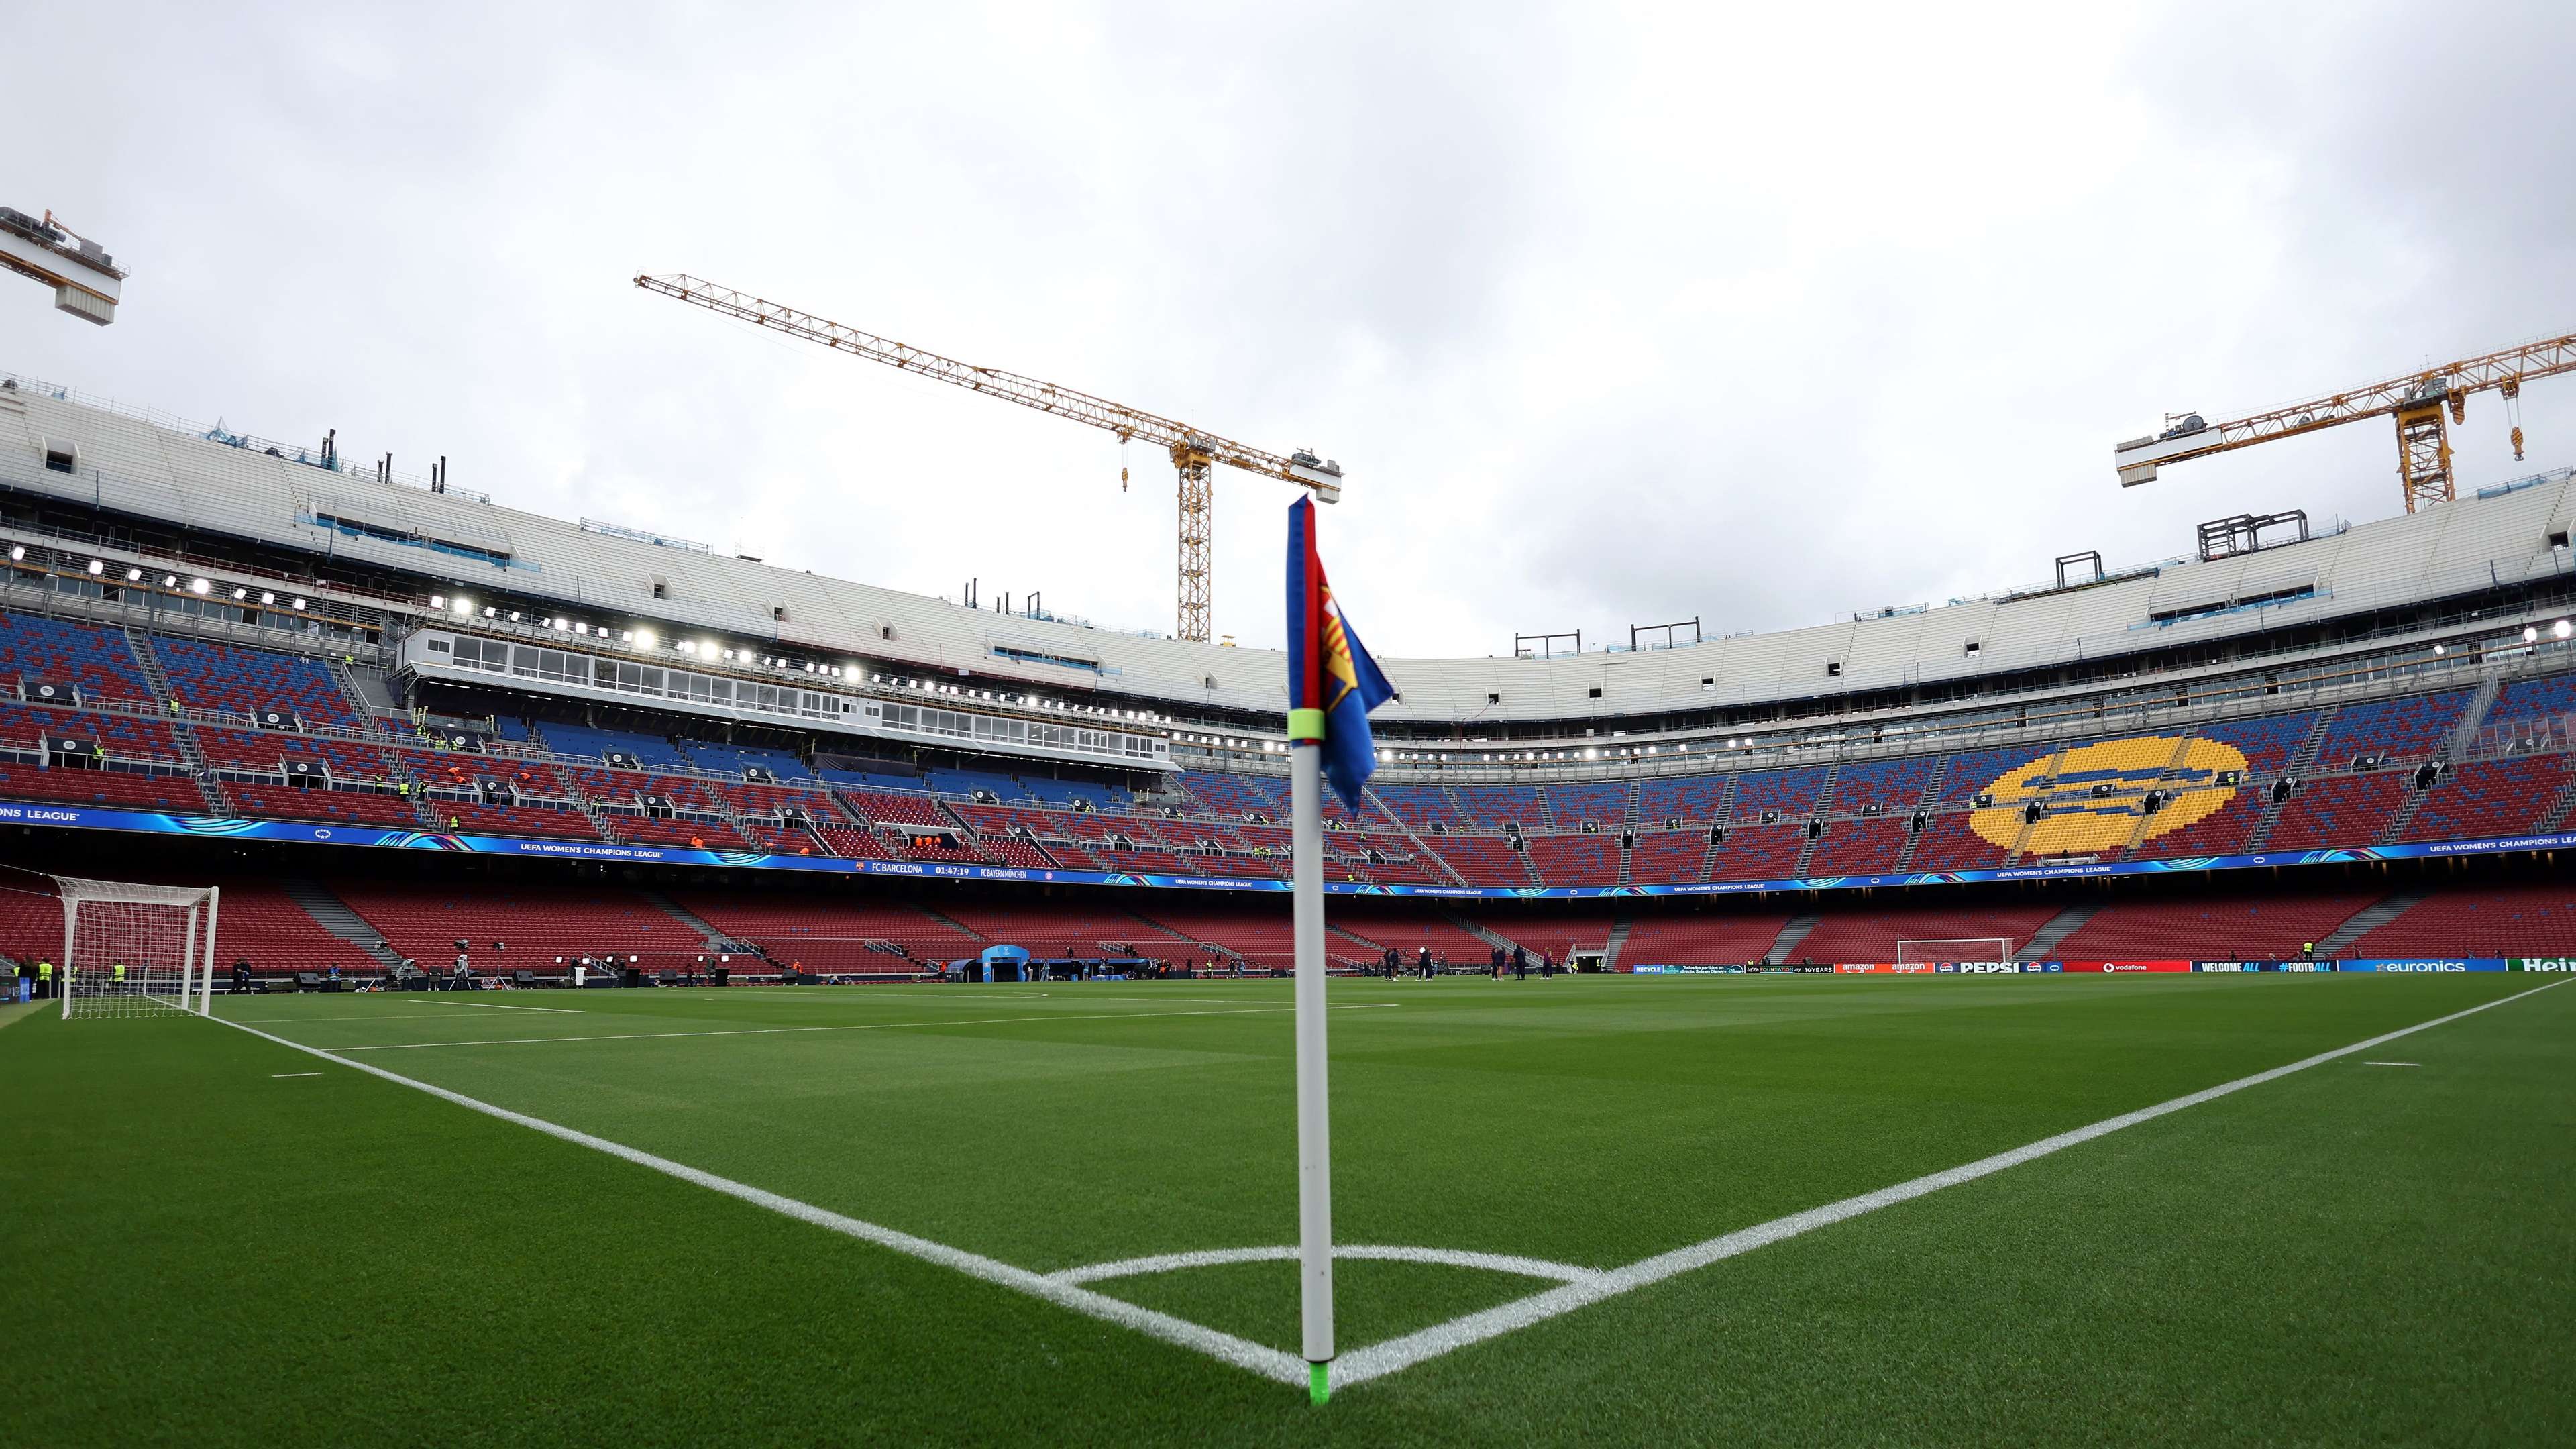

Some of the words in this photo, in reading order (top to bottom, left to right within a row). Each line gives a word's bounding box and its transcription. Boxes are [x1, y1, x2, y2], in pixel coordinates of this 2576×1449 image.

[28, 810, 77, 821] LEAGUE
[521, 843, 541, 851] UEFA
[543, 845, 582, 853] WOMEN'S
[584, 847, 631, 856] CHAMPIONS
[2453, 843, 2496, 851] WOMEN'S
[2499, 838, 2557, 848] CHAMPIONS
[872, 863, 881, 871] FC
[881, 863, 923, 873] BARCELONA
[936, 867, 969, 875] 01:47:19
[981, 869, 987, 877] FC
[987, 869, 1004, 877] BAYERN
[1004, 869, 1026, 878] MÜNCHEN
[1960, 962, 2019, 973] PEPSI
[2202, 963, 2242, 972] WELCOME
[2243, 963, 2260, 972] ALL
[2279, 962, 2330, 972] #FOOTBALL
[2387, 960, 2465, 972] euronics
